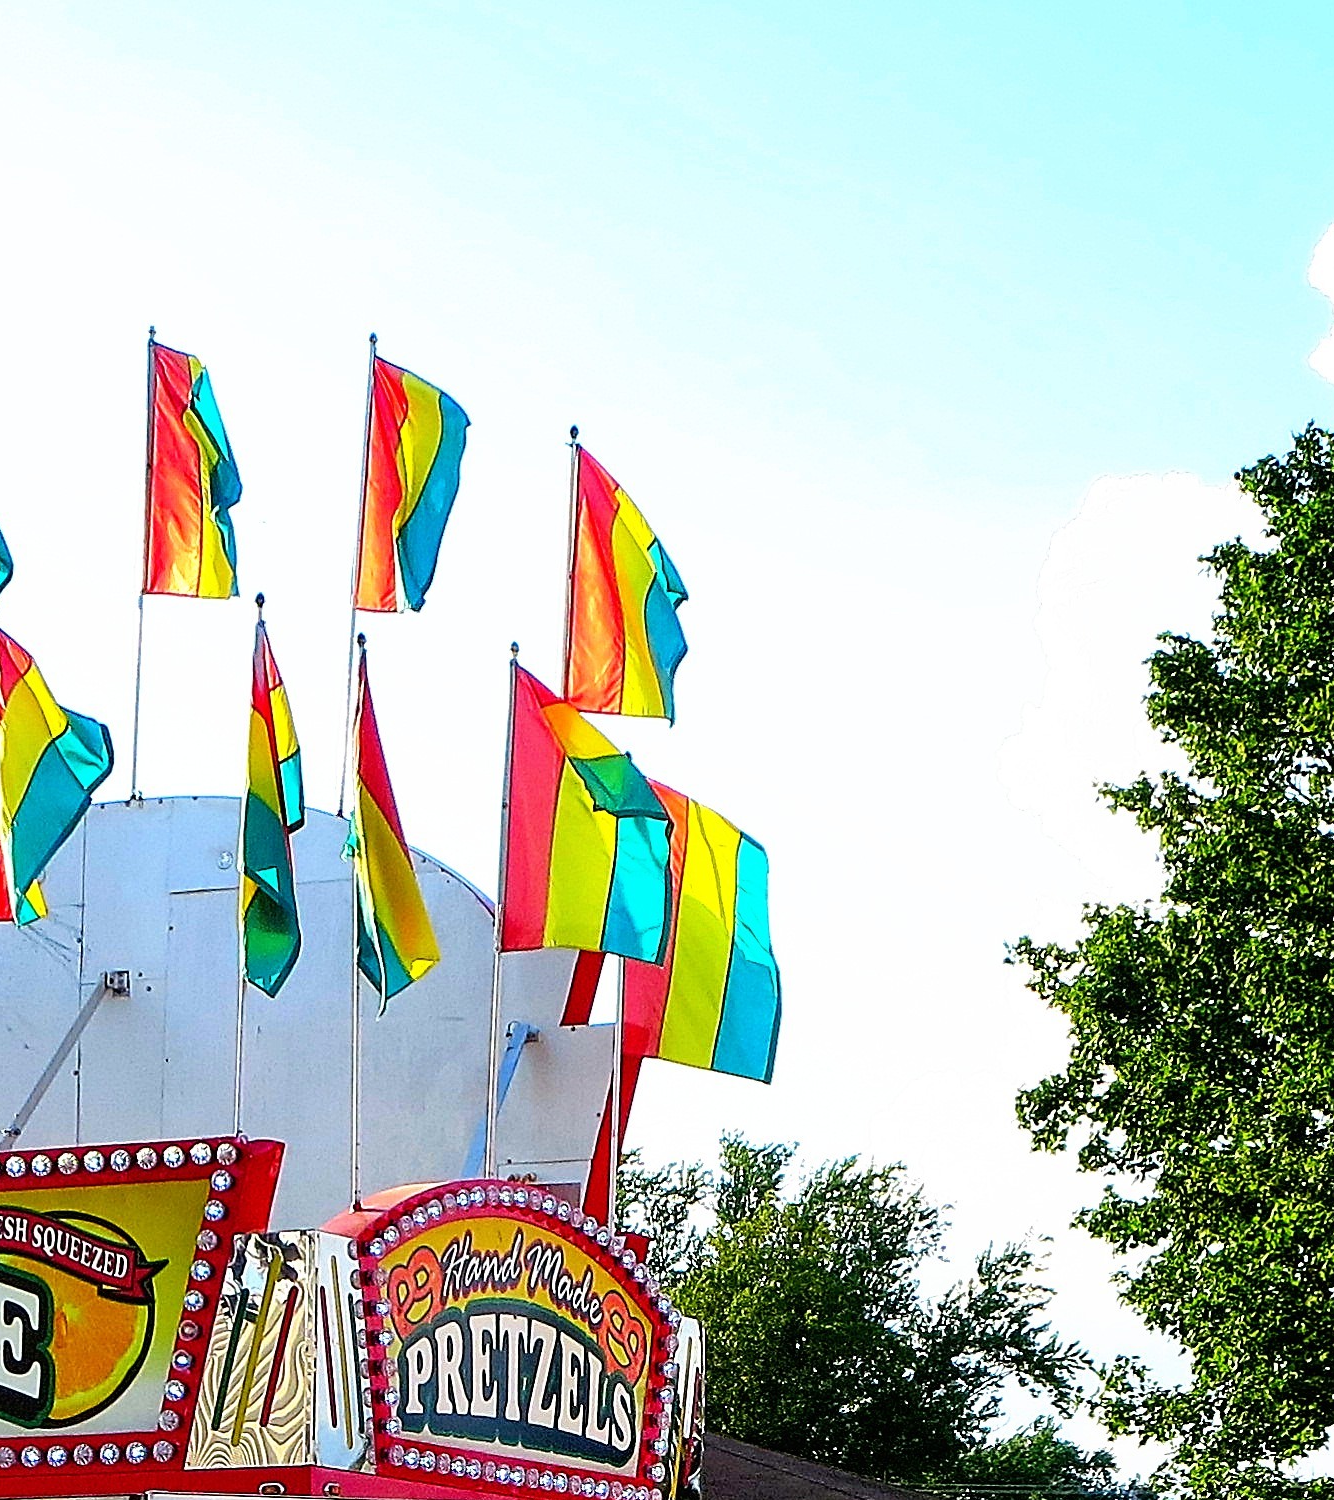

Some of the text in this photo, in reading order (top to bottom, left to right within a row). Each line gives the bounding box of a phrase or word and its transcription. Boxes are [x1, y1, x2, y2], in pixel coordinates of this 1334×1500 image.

[30, 1225, 129, 1280] SQUEEZED
[440, 1232, 602, 1323] Hand Made
[405, 1313, 635, 1453] PRETZELS
